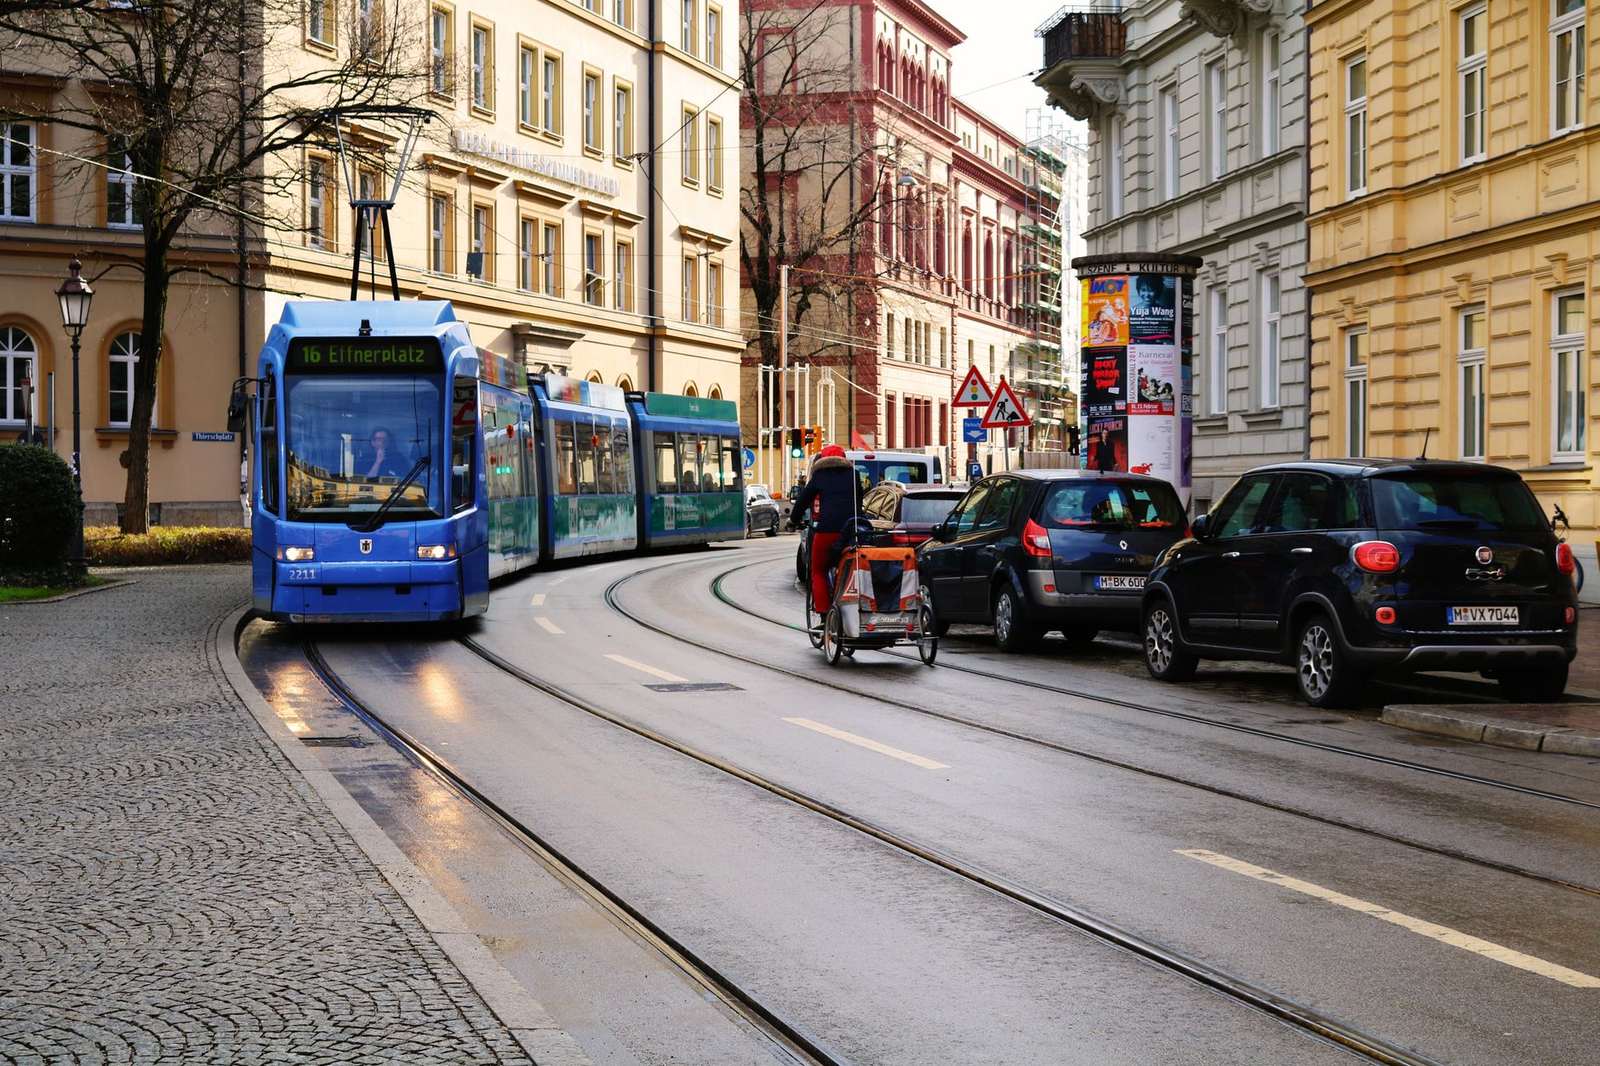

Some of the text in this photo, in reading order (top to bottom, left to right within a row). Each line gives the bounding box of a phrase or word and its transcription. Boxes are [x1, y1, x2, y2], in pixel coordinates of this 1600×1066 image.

[1139, 263, 1180, 273] KULTUR
[1130, 306, 1174, 318] Yuja Wang
[302, 345, 321, 363] 16
[972, 465, 980, 475] P
[289, 569, 316, 580] 2211
[1101, 577, 1108, 587] M
[1114, 577, 1126, 587] BK
[1454, 608, 1517, 621] M VX 7044
